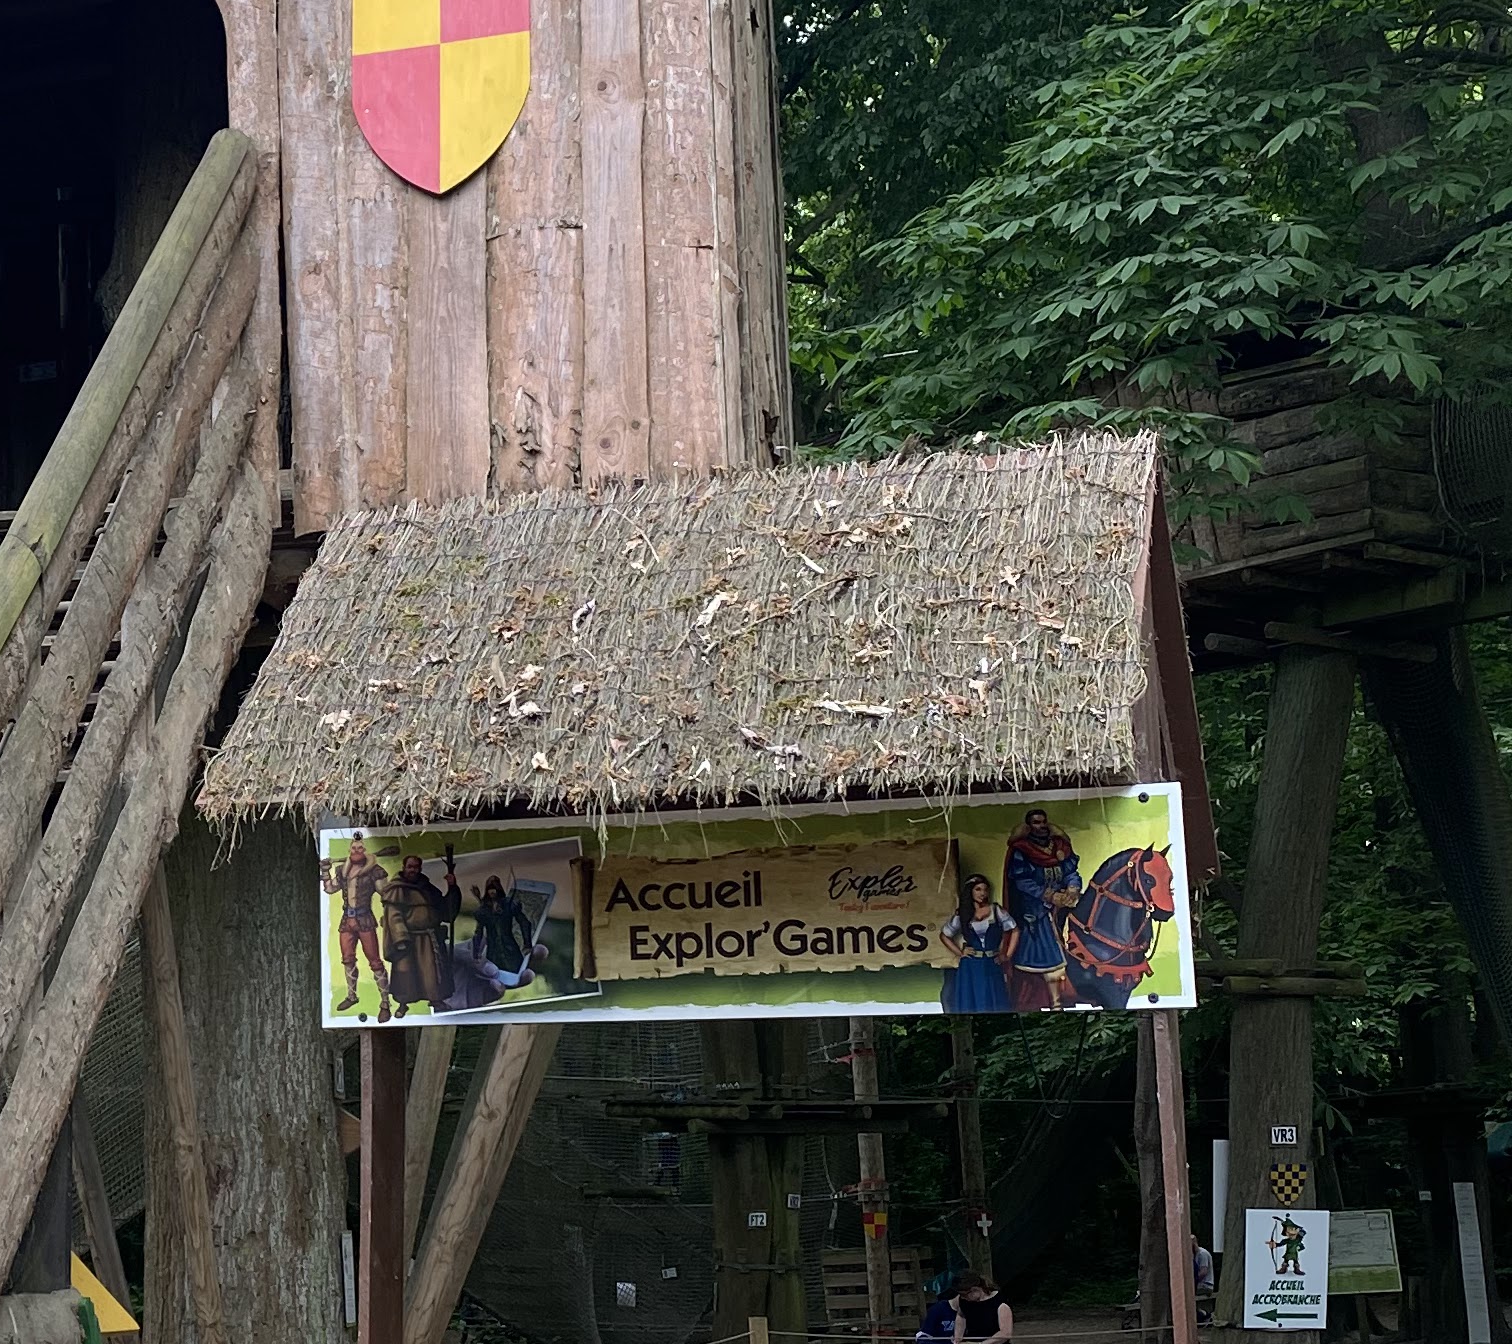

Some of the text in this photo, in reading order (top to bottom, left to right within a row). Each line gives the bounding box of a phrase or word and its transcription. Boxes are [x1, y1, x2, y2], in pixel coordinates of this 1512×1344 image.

[828, 864, 918, 900] Explor
[604, 869, 763, 913] Accueil
[1273, 1128, 1295, 1142] VR3
[1268, 1279, 1305, 1291] ACCUEIL
[1251, 1293, 1322, 1306] ACCROBRANCHE
